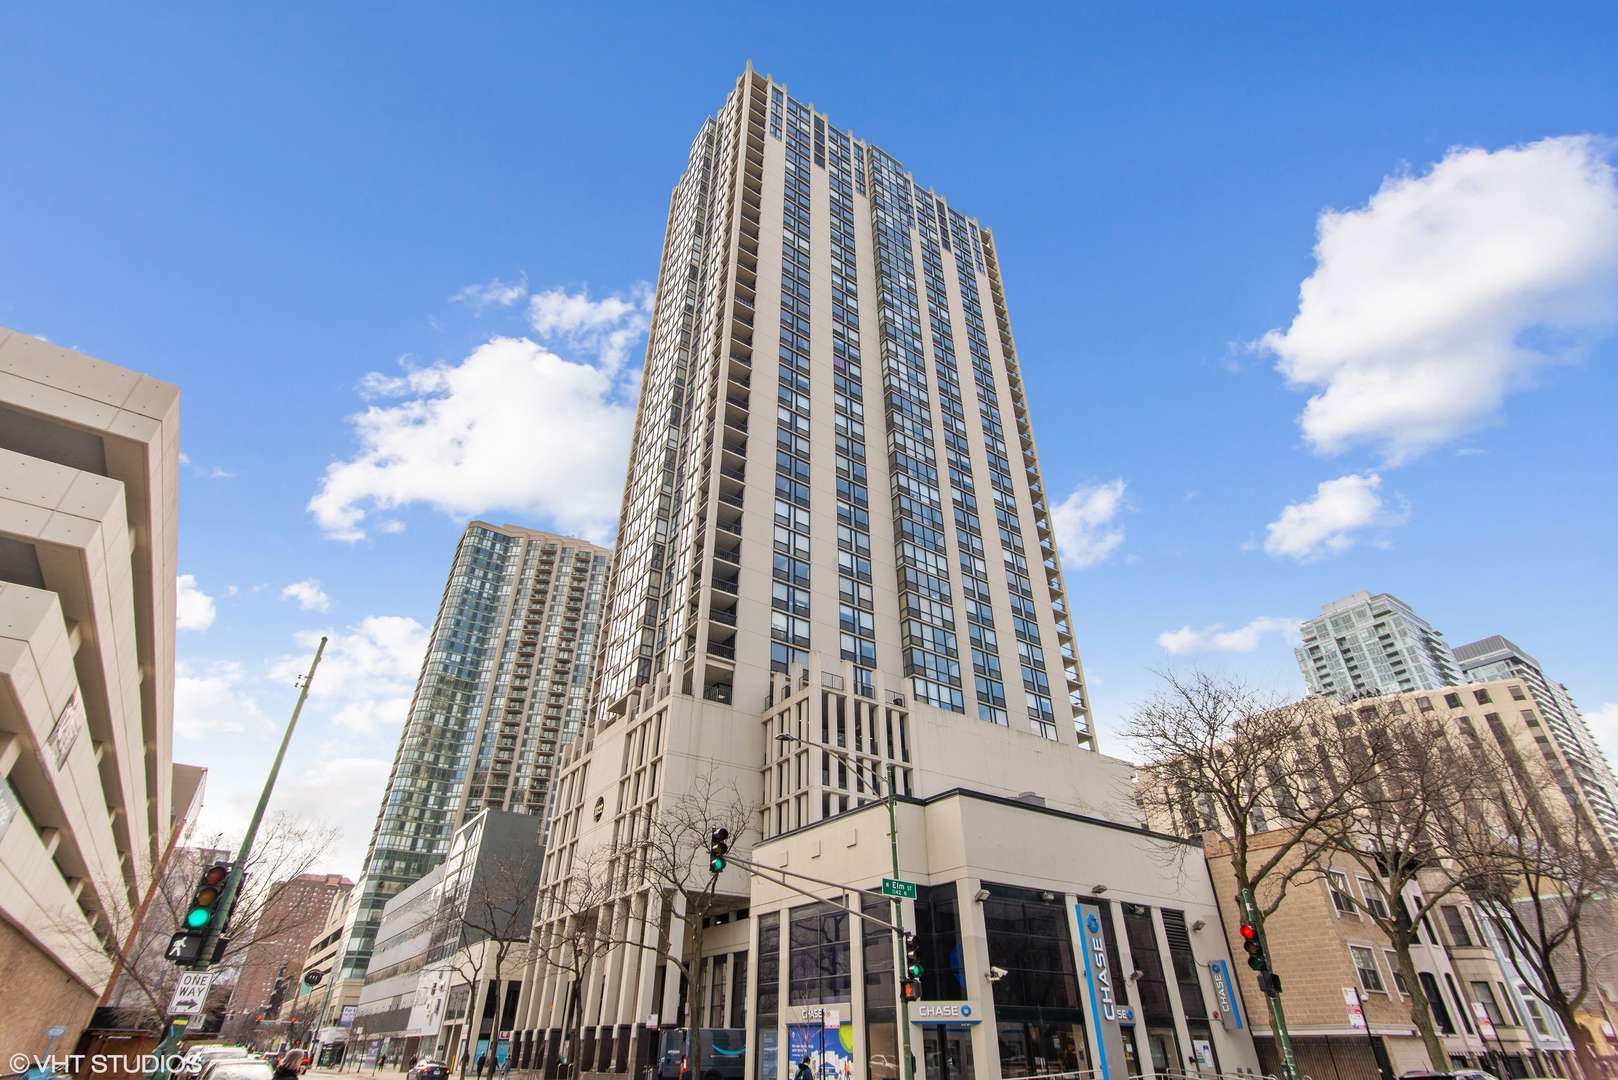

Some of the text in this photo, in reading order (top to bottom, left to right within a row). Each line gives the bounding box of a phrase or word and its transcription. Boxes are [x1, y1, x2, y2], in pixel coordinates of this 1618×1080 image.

[892, 881, 905, 890] Elm
[183, 975, 208, 986] ONE
[1091, 937, 1115, 1021] CHASE
[178, 986, 206, 997] WAY
[1214, 974, 1230, 1012] CHASE
[802, 1009, 822, 1019] CHASE
[918, 1005, 960, 1017] CHASE
